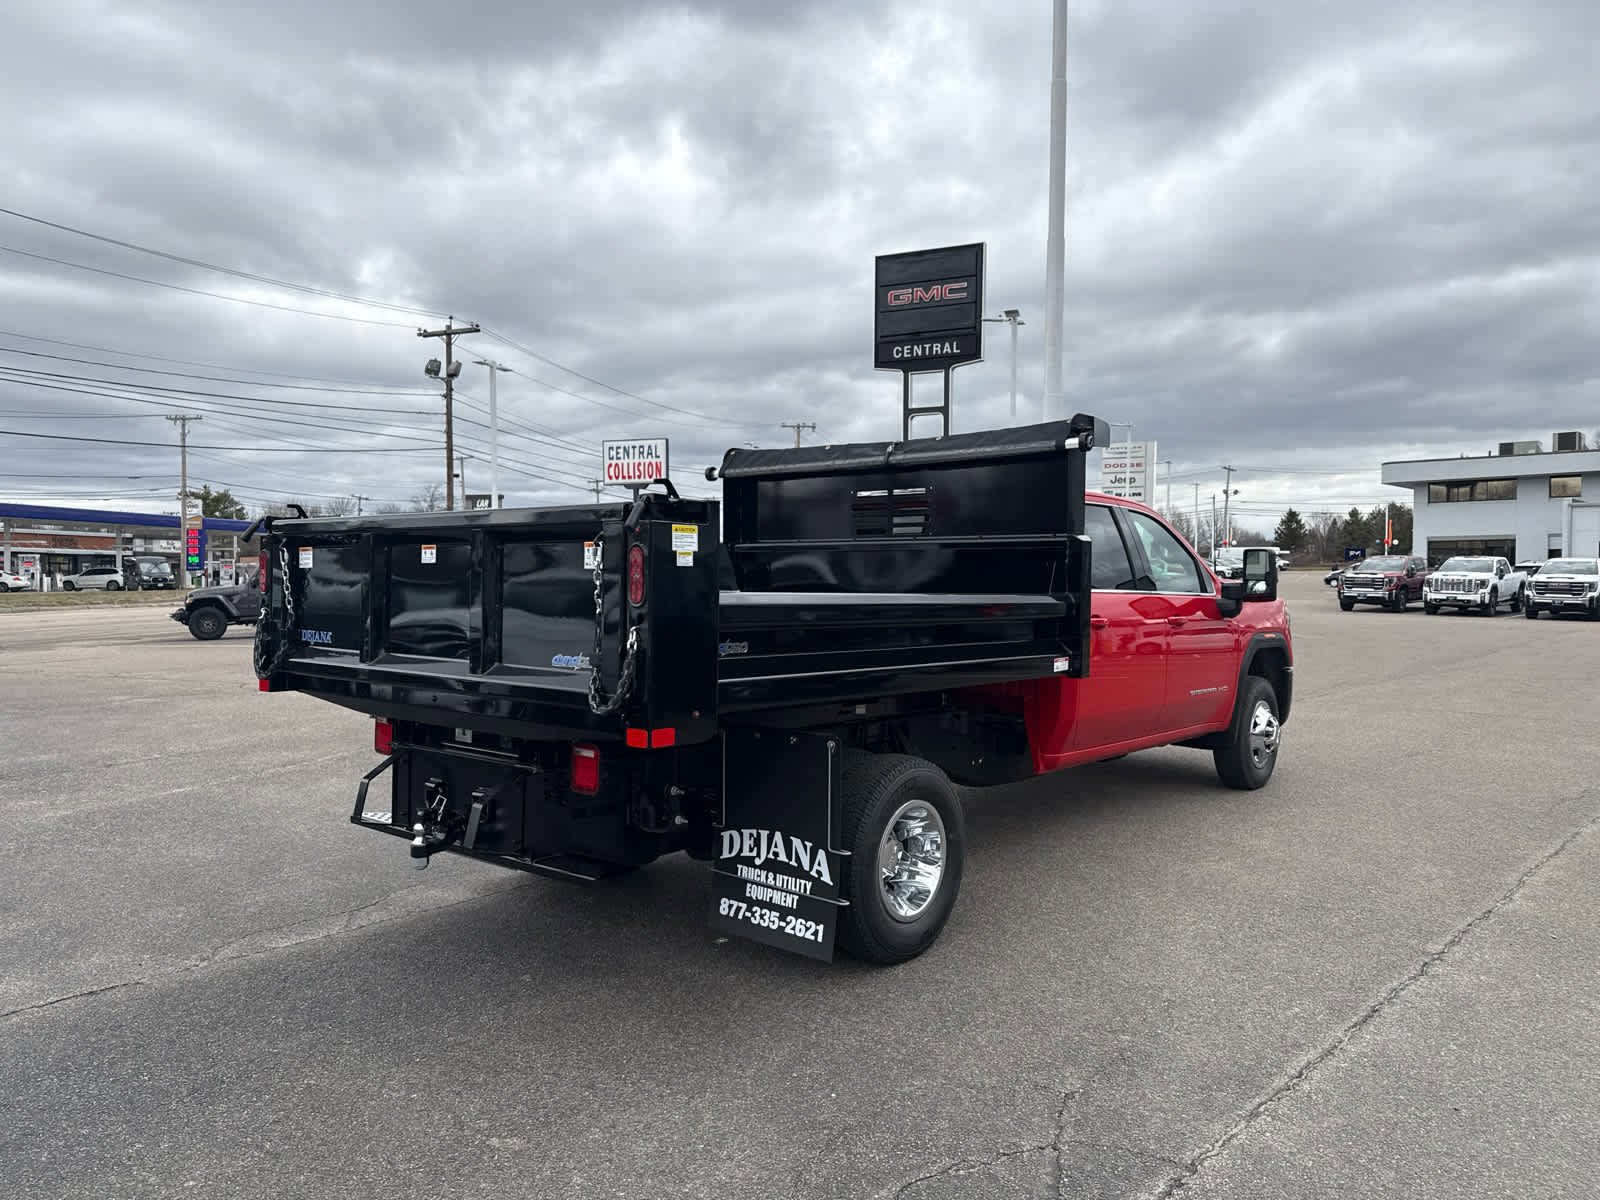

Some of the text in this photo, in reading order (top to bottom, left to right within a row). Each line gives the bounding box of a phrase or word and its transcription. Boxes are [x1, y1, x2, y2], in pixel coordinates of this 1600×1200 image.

[888, 281, 967, 305] GMC
[893, 341, 960, 358] CENTRAL
[608, 445, 660, 460] CENTRAL
[607, 462, 662, 480] COLLISION
[301, 629, 333, 645] DEJANA
[720, 829, 834, 886] DEJANA
[745, 883, 799, 909] EQUIPMENT
[720, 898, 824, 942] 877-335-2621
